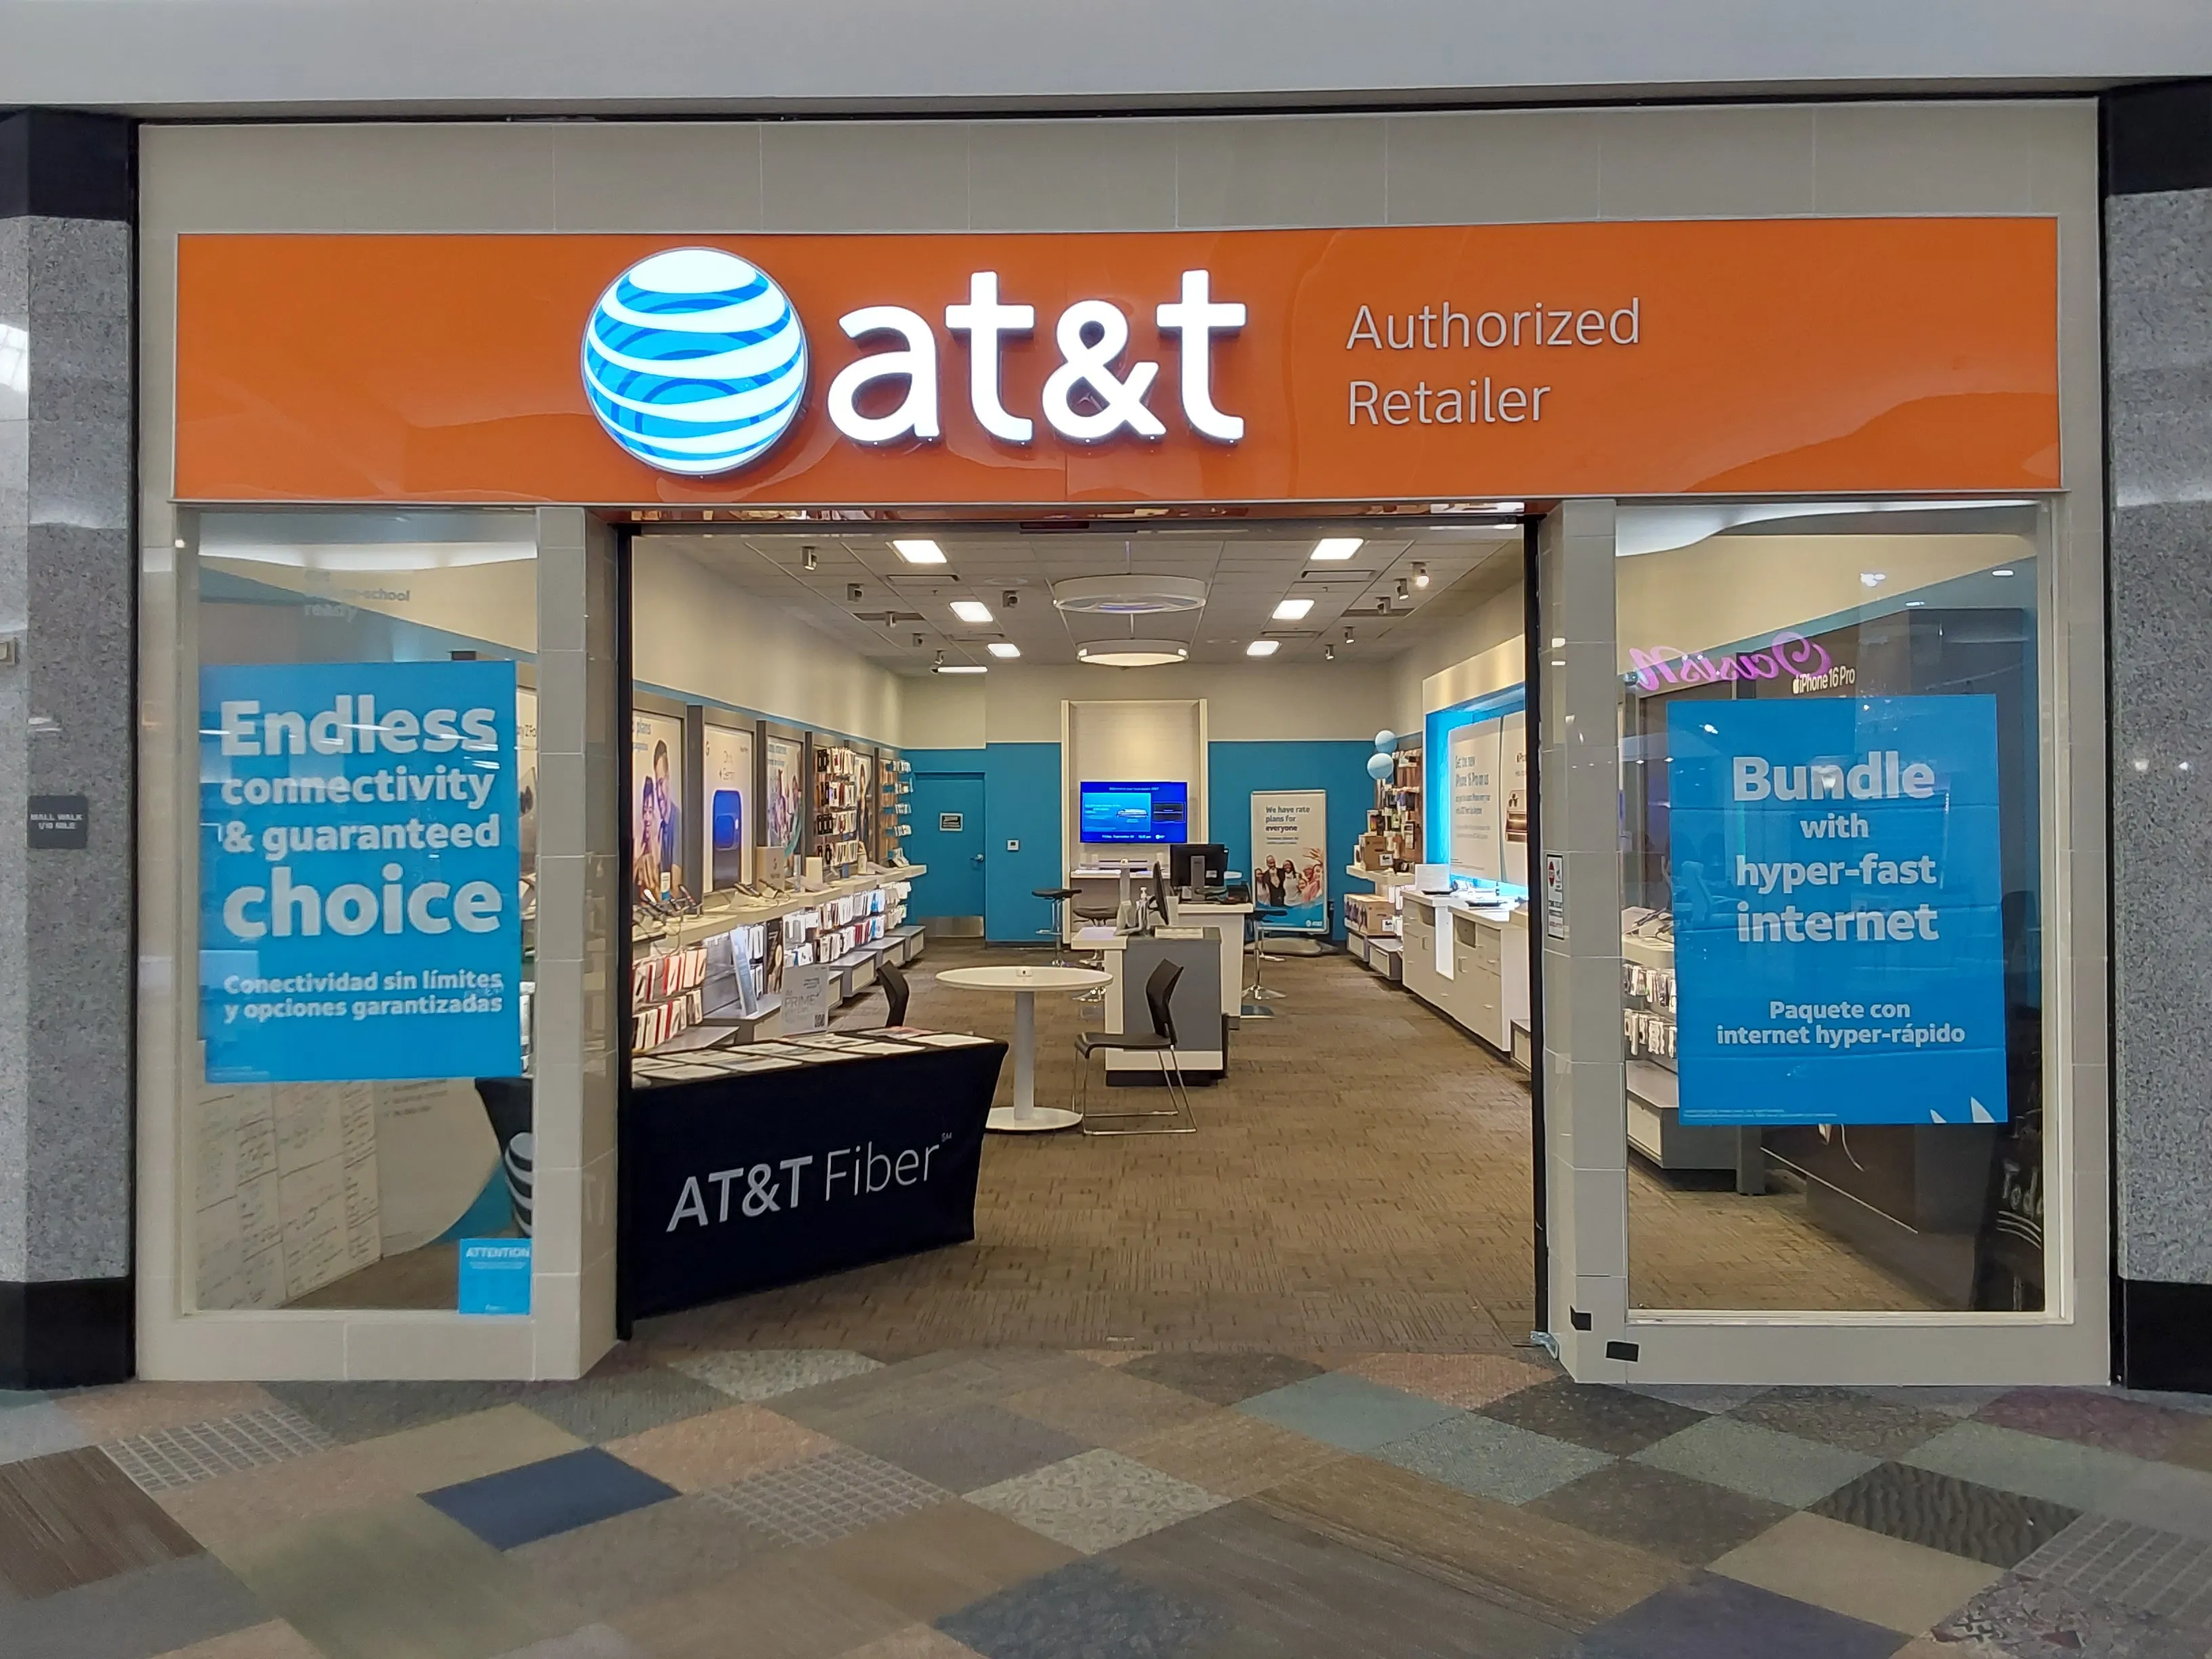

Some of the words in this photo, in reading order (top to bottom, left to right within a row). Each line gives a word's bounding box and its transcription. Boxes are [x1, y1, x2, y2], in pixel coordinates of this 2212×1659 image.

[1346, 297, 1640, 350] Authorized
[1349, 377, 1551, 425] Retailer
[1799, 673, 1828, 693] iPhone
[1828, 667, 1839, 688] 16
[1839, 665, 1856, 686] Pro
[221, 695, 499, 757] Endless
[222, 766, 495, 809] connectivity
[1733, 751, 1935, 802] Bundle
[223, 821, 253, 854] &
[262, 815, 500, 861] guaranteed
[1265, 815, 1284, 823] plans
[1265, 825, 1298, 834] everyone
[1800, 813, 1870, 839] with
[1736, 853, 1937, 895] hyper-fast
[223, 863, 503, 938] choice
[1737, 902, 1940, 943] internet
[224, 972, 379, 996] Conectividad
[384, 971, 417, 991] sin
[422, 969, 503, 990] límites
[224, 1004, 237, 1023] y
[244, 997, 347, 1021] opciones
[352, 994, 503, 1021] garantizadas
[1769, 1001, 1864, 1022] Paquete
[1870, 1002, 1910, 1019] con
[1717, 1025, 1809, 1045] internet
[1816, 1023, 1965, 1048] hyper-rápido
[666, 1155, 813, 1233] AT&T
[825, 1141, 940, 1202] Fiber
